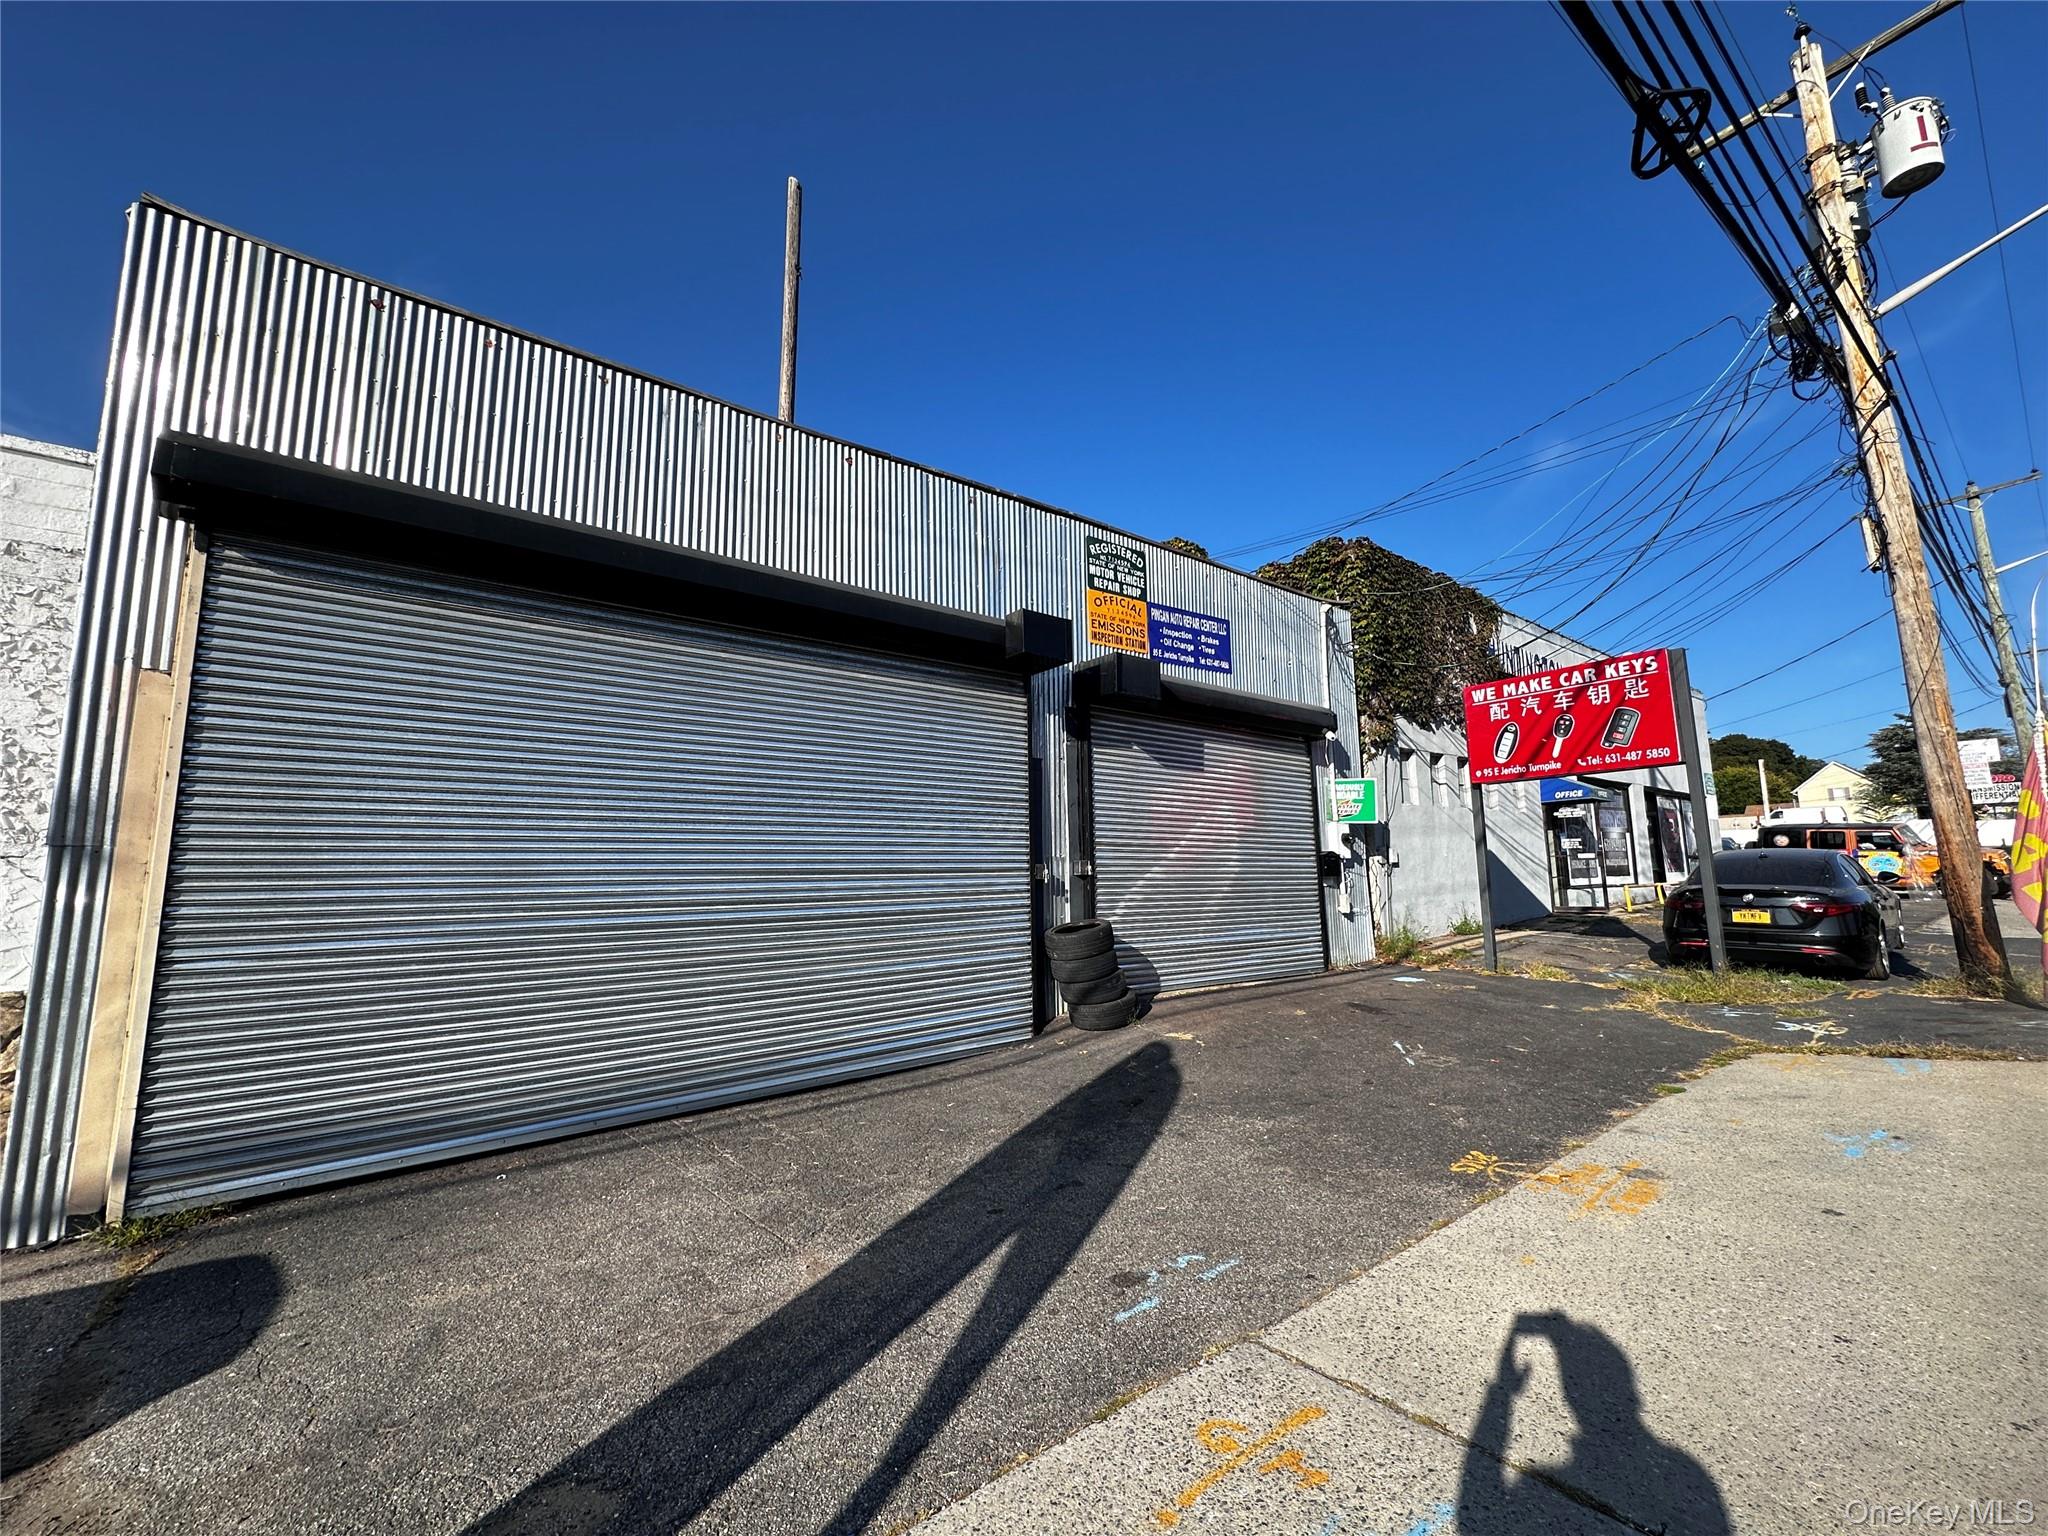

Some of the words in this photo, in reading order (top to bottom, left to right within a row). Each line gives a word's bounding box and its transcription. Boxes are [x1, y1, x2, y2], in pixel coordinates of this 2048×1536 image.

[1089, 543, 1144, 568] REGISTERED
[1089, 558, 1106, 567] STATE
[1117, 565, 1128, 573] NEW
[1130, 569, 1145, 577] YORK
[1089, 564, 1115, 580] MOTOR
[1117, 571, 1145, 588] VEHICLE
[1094, 577, 1120, 593] REPAIR
[1123, 584, 1141, 598] SHOP
[1090, 611, 1107, 620] STATE
[1094, 596, 1141, 617] OFFICIAL
[1091, 619, 1146, 639] EMISSIONS
[1170, 612, 1182, 626] AUTO
[1183, 614, 1200, 630] REPAIR
[1201, 619, 1218, 634] CENTER
[1218, 623, 1227, 635] LLC
[1092, 630, 1123, 646] INSPECTION
[1125, 637, 1146, 650] STATION
[1163, 626, 1192, 640] Inspection
[1201, 634, 1219, 646] Brakes
[1163, 637, 1172, 647] Oil
[1173, 639, 1194, 652] Change
[1471, 686, 1496, 703] WE
[1503, 676, 1552, 697] MAKE
[1559, 668, 1597, 686] CAR
[1604, 656, 1658, 679] KEYS
[1489, 677, 1650, 722] 配汽车钥匙
[1483, 768, 1493, 777] 95
[1494, 767, 1499, 776] E
[1501, 764, 1527, 776] Jericho
[1528, 760, 1562, 772] Turnpike
[1586, 755, 1603, 766] Tel:
[1605, 751, 1642, 763] 631-487
[1646, 747, 1670, 759] 5850
[1554, 789, 1583, 799] OFFICE
[1972, 783, 2020, 792] ANSMISSION
